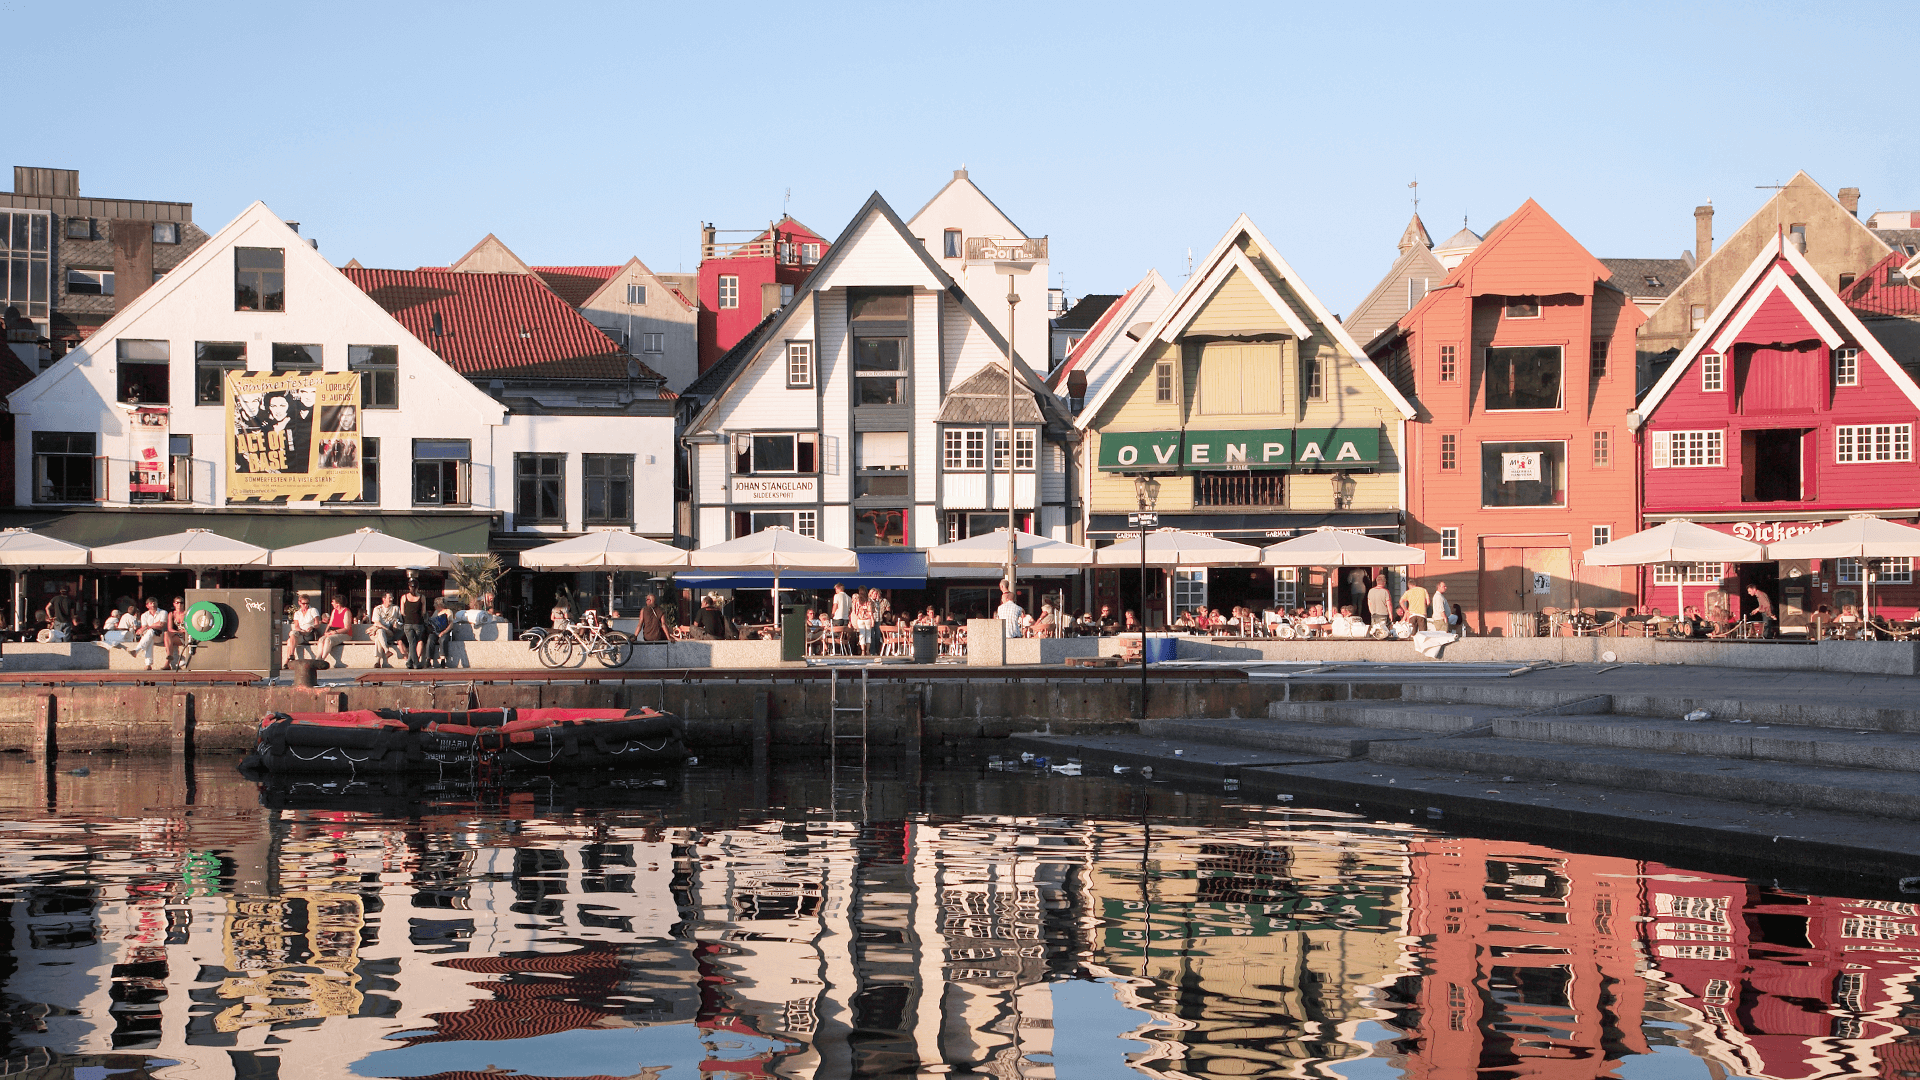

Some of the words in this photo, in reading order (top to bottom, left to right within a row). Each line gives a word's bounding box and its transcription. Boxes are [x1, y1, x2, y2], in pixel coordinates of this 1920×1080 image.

[238, 431, 267, 453] ACE
[267, 430, 286, 451] OF
[249, 450, 288, 472] BASE
[735, 482, 760, 490] JOHAN
[761, 482, 814, 490] STANGELAND
